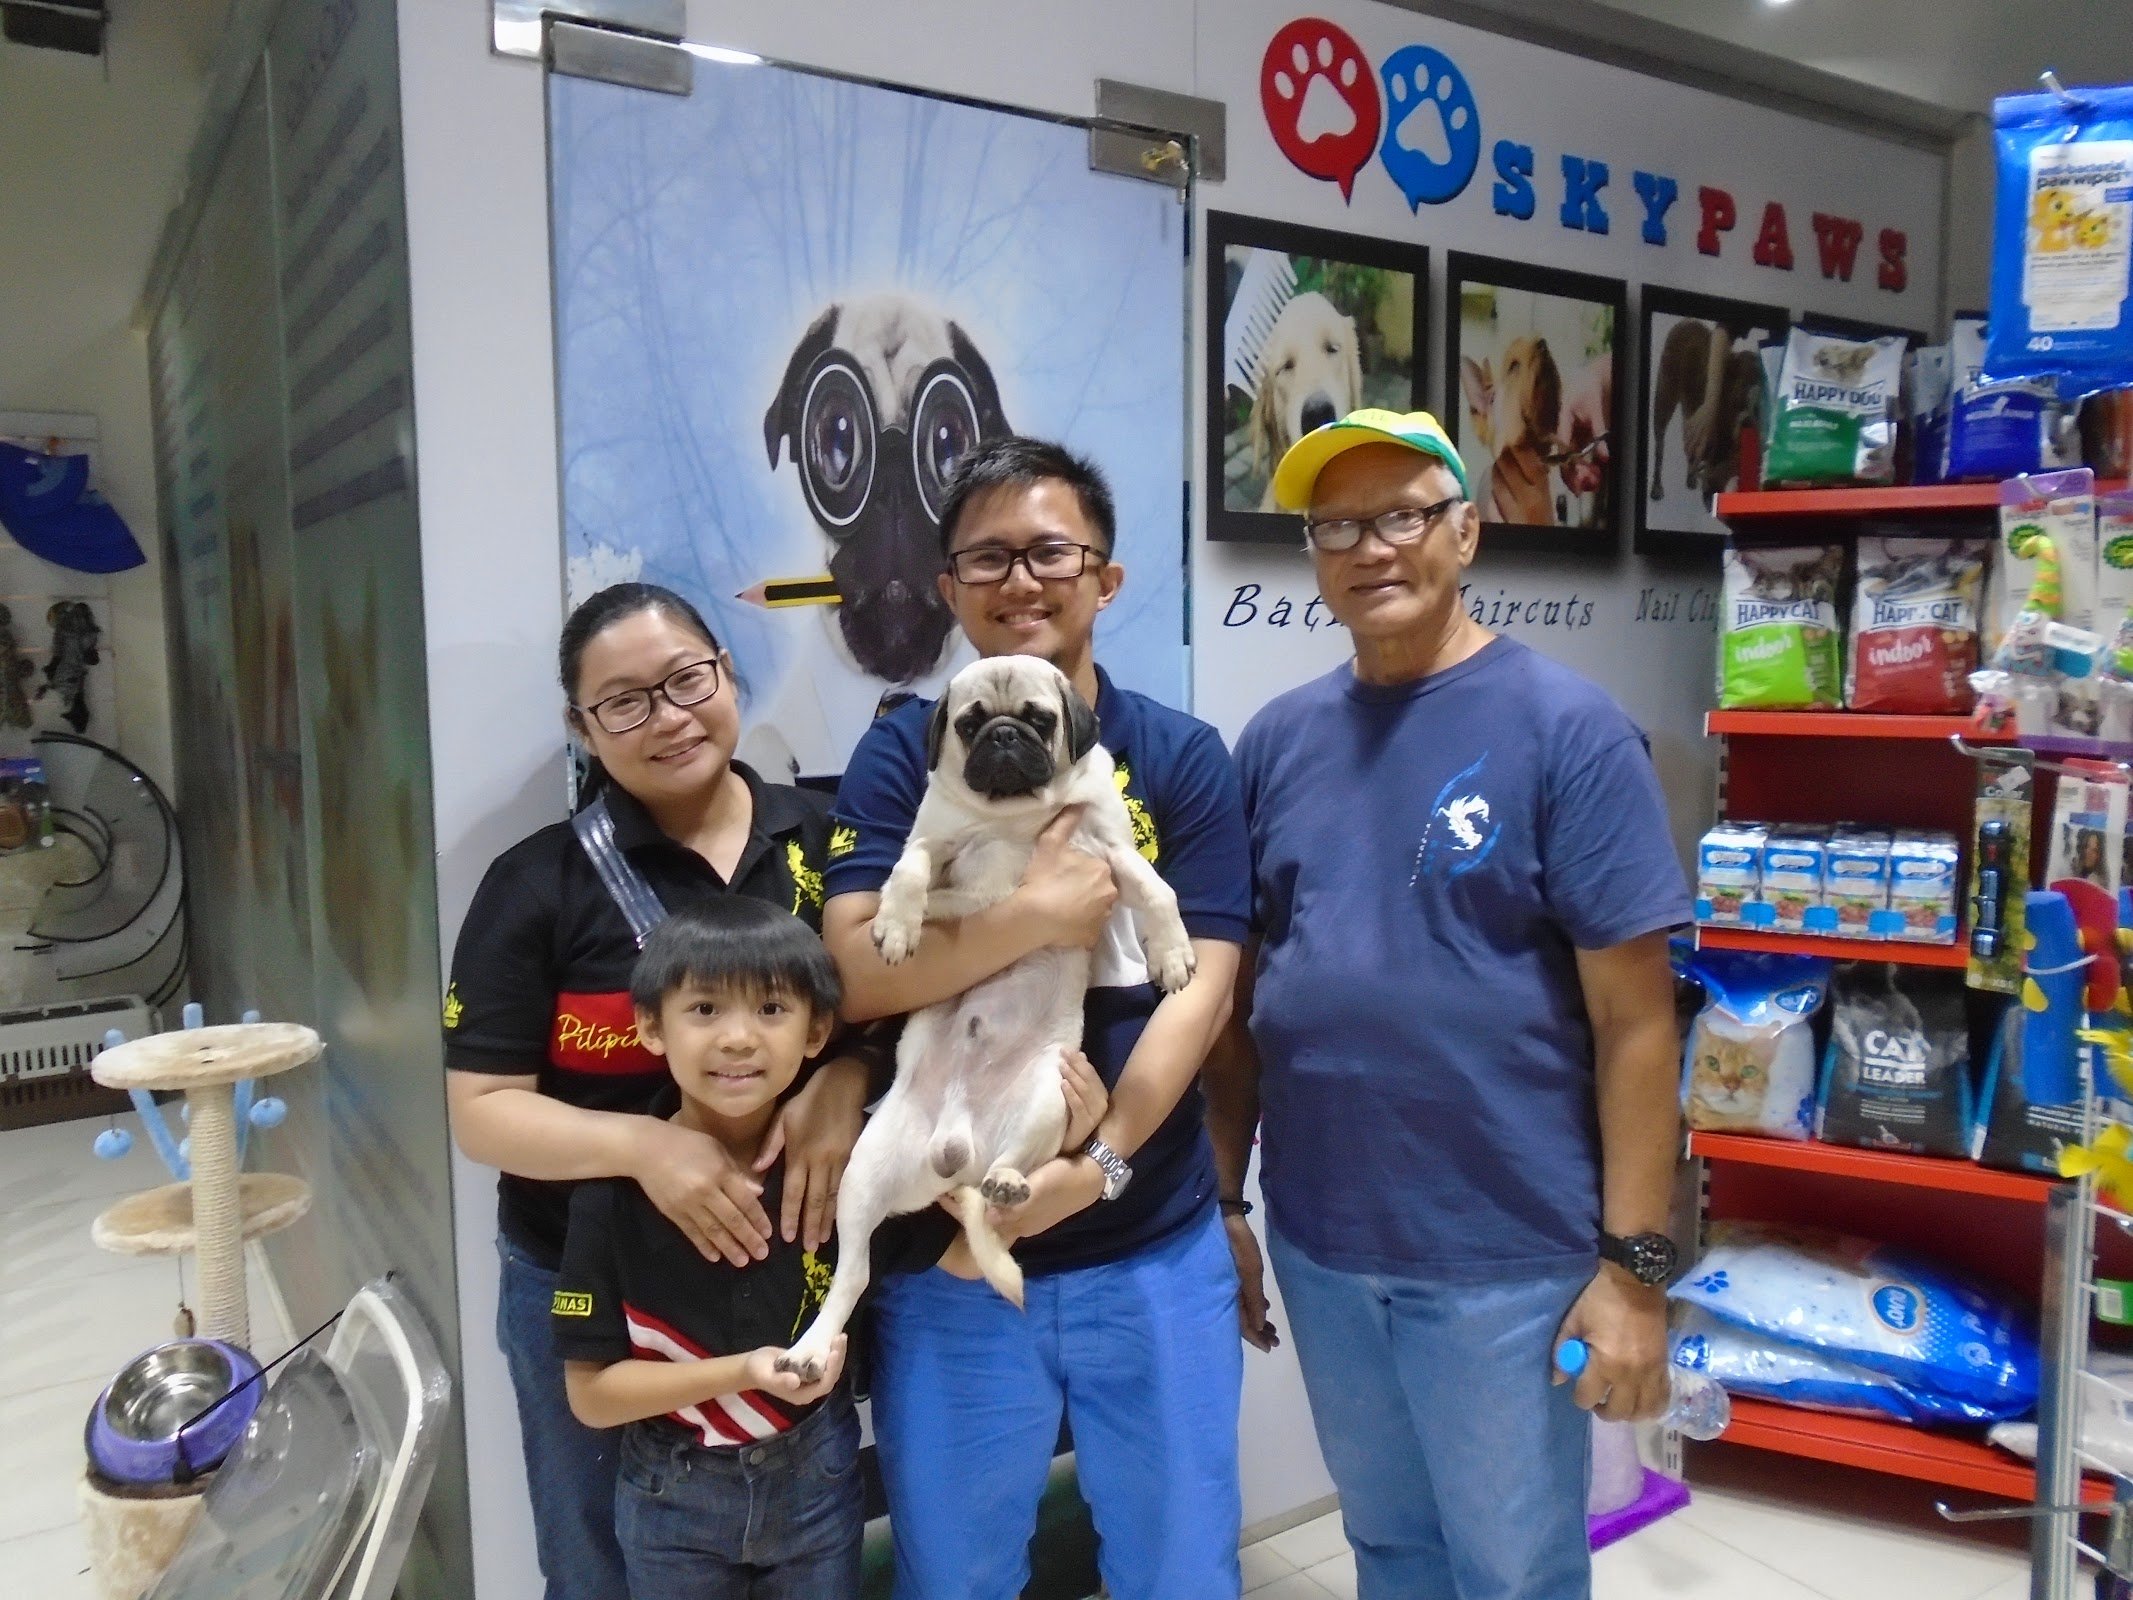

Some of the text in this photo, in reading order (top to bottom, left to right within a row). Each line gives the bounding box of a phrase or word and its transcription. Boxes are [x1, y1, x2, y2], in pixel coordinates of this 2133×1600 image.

[2026, 335, 2054, 352] 40
[1794, 381, 1848, 402] HAPPY
[1223, 583, 1345, 633] Bat
[1459, 583, 1595, 631] aircuts
[1634, 587, 1681, 622] Nail
[1737, 602, 1822, 625] HAPPY CAT
[1930, 601, 1963, 623] CAT
[1735, 633, 1793, 664] indoor
[1867, 633, 1933, 666] indoor
[1863, 1030, 1927, 1063] CAT
[1862, 1066, 1926, 1085] LEADER
